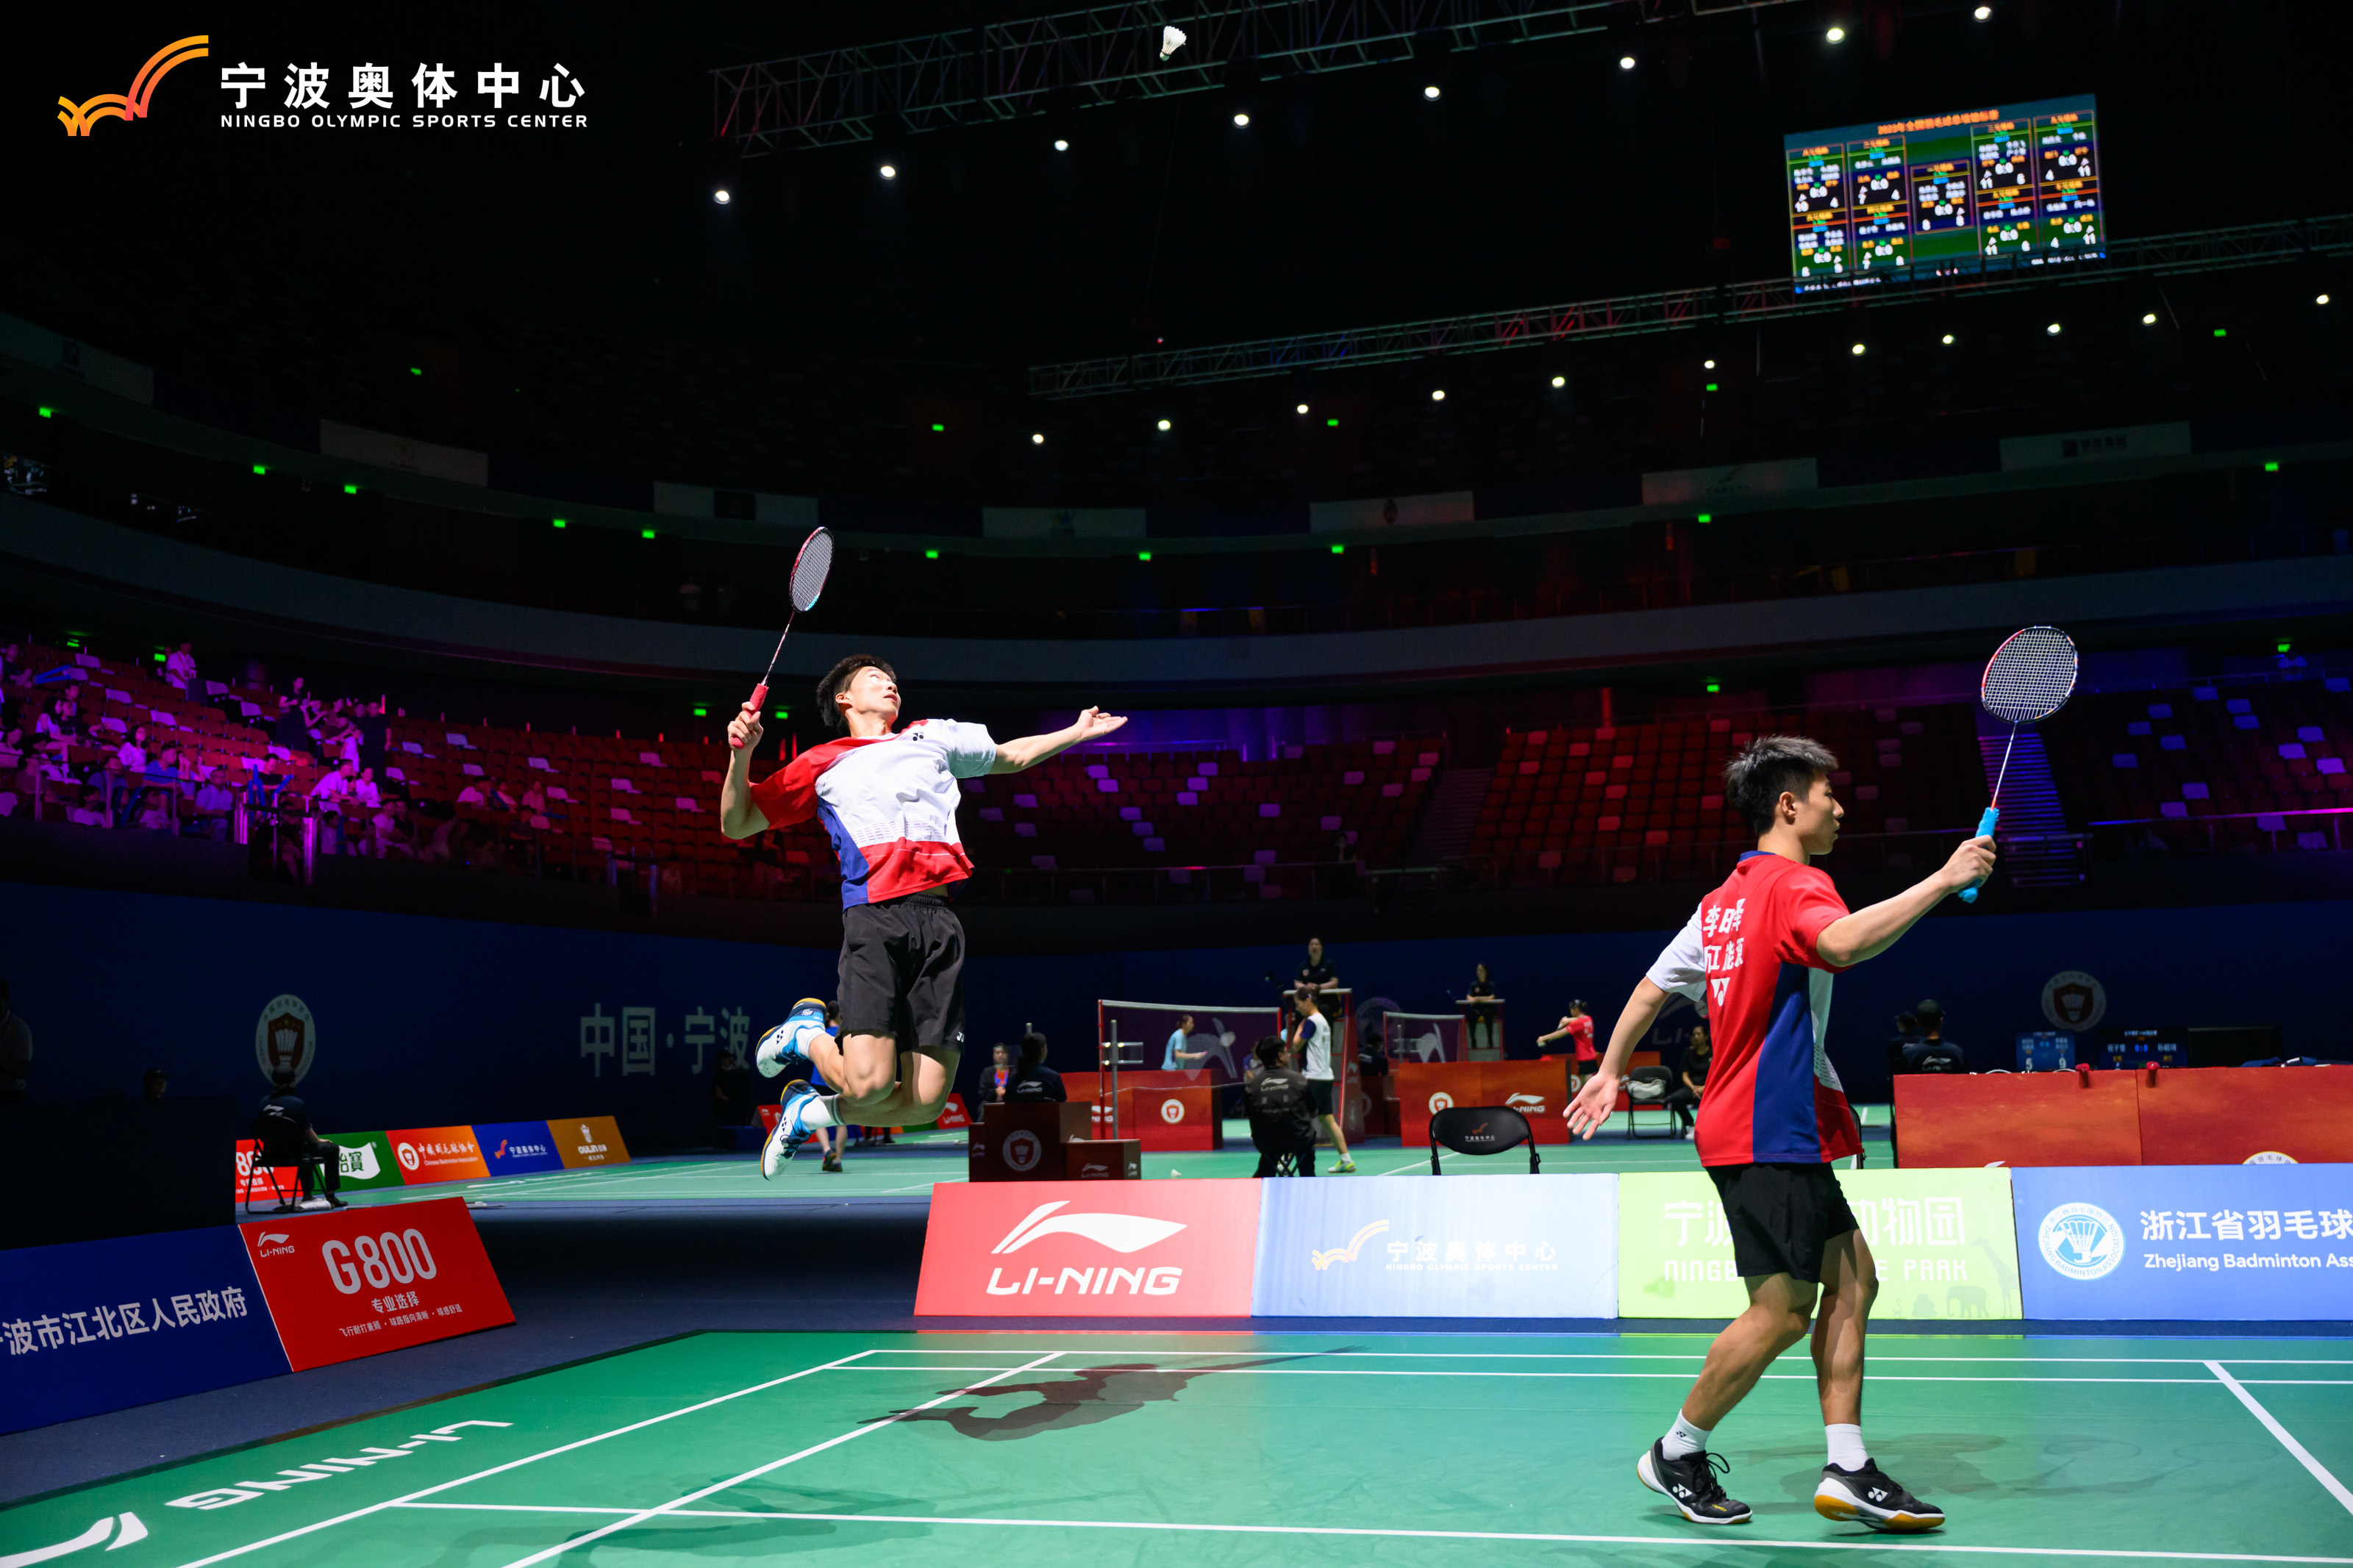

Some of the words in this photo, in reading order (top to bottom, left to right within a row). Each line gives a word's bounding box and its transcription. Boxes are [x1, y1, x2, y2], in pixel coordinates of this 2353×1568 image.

[2140, 1209, 2353, 1241] 浙江省羽毛球
[260, 1245, 295, 1258] LI-NING
[321, 1228, 437, 1294] G800
[1386, 1240, 1557, 1262] 宁波奥体中心
[2143, 1253, 2219, 1272] Zhejiang
[2224, 1253, 2321, 1268] Badminton
[986, 1267, 1182, 1295] LI-NING
[1904, 1259, 1968, 1281] PARK
[371, 1291, 420, 1313] 专业选择
[0, 1286, 248, 1356] 波市江北区人民政府
[164, 1420, 514, 1510] LI-NING
